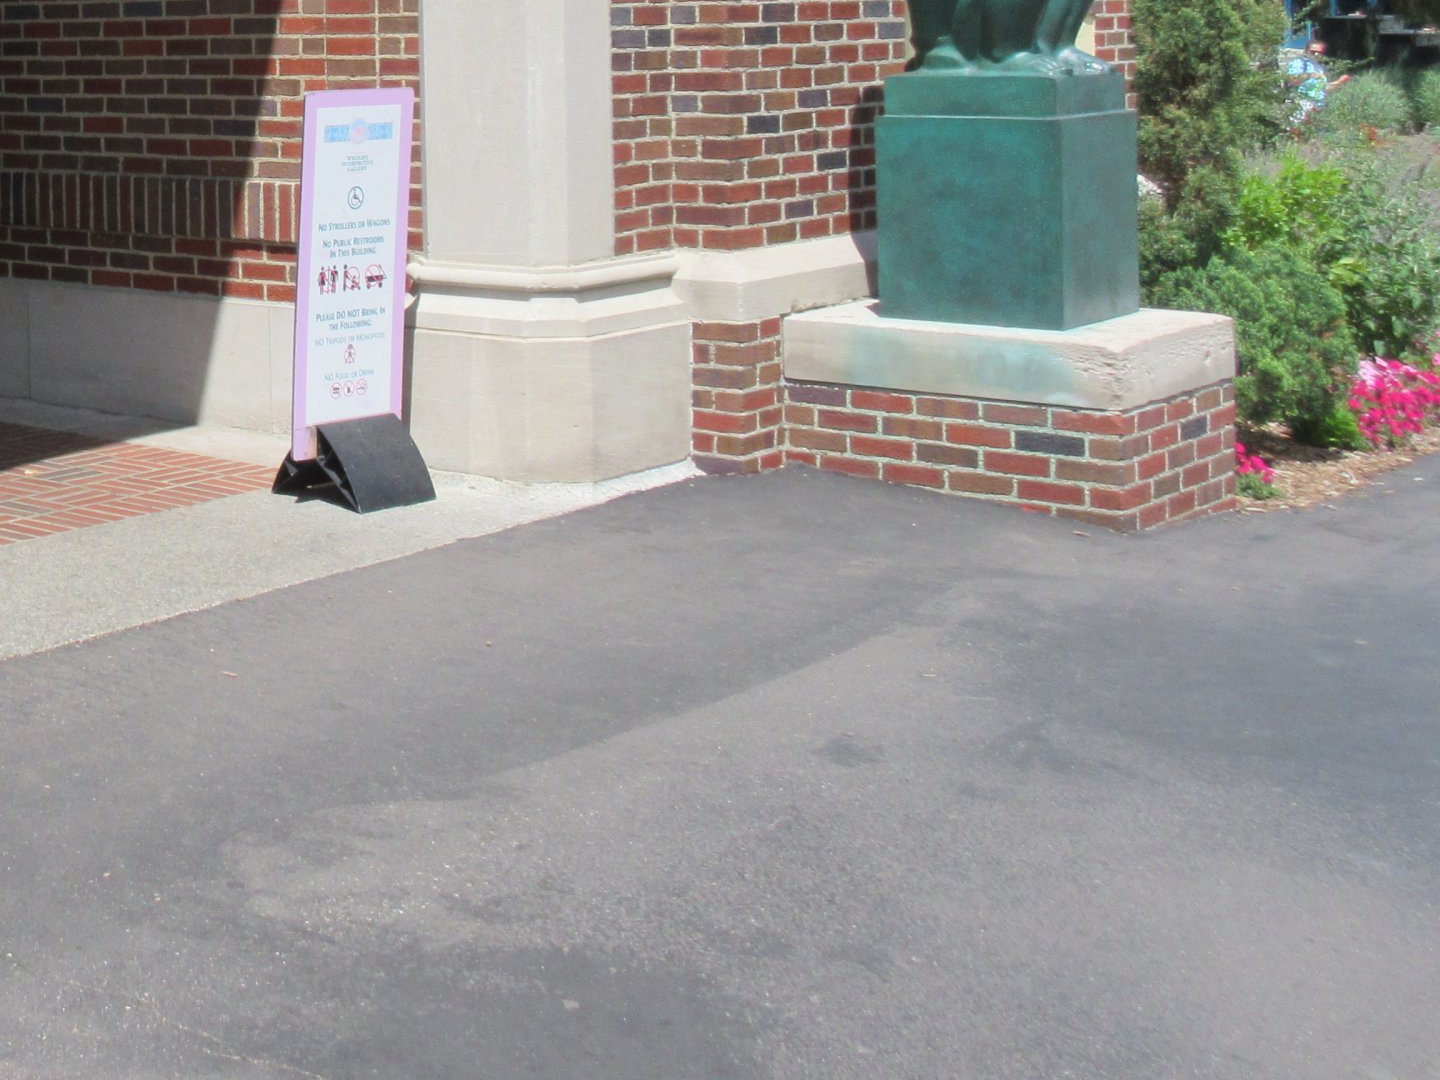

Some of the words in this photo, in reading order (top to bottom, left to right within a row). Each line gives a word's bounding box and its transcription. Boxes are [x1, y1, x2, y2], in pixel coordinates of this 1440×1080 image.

[318, 224, 327, 232] NO
[328, 221, 357, 231] STROLLERS
[366, 219, 390, 227] WAGONS
[322, 240, 331, 248] NO
[333, 239, 352, 247] PUBLIC
[353, 236, 384, 245] RESTROOMS
[330, 249, 336, 258] IN
[338, 249, 349, 257] THIS
[351, 247, 376, 256] BUILDING
[316, 313, 335, 322] PLEASE
[336, 311, 346, 319] DO
[347, 309, 360, 318] NOT
[361, 308, 378, 316] BRING
[379, 306, 386, 314] IN
[329, 323, 339, 331] THE
[315, 338, 324, 346] NO
[324, 373, 333, 381] NO
[335, 371, 350, 380] FOOD
[359, 369, 374, 377] DRINK
